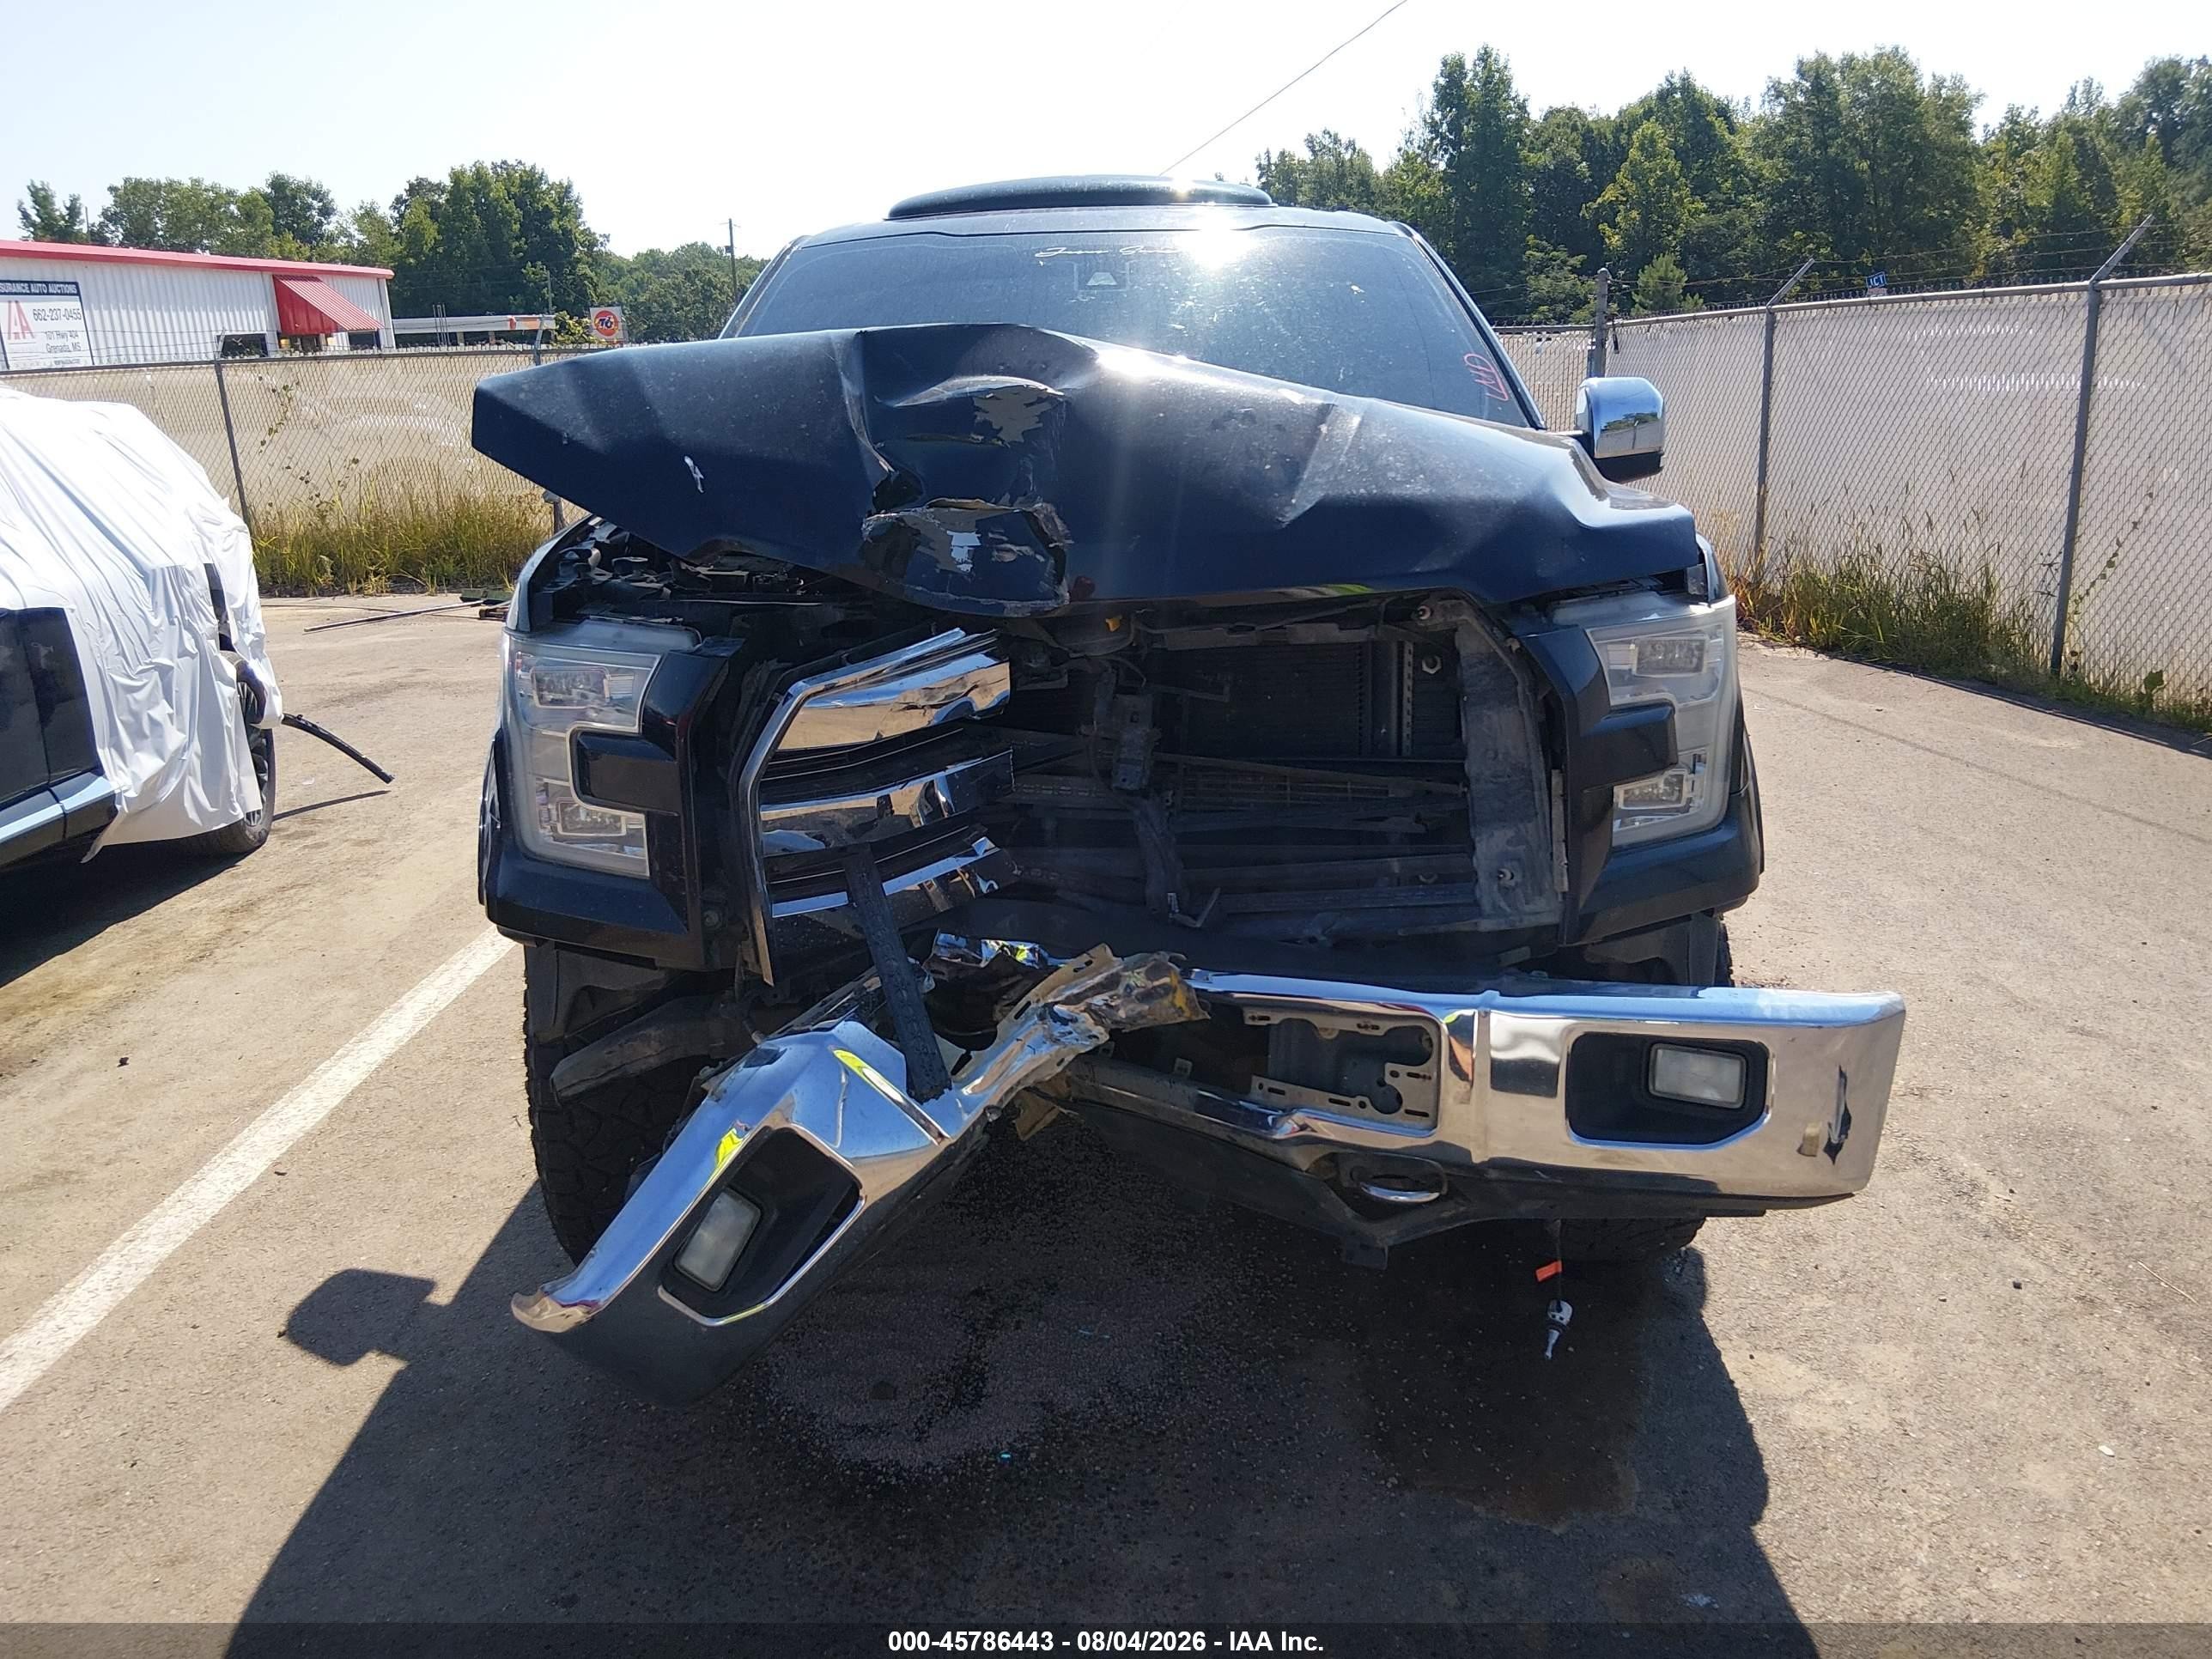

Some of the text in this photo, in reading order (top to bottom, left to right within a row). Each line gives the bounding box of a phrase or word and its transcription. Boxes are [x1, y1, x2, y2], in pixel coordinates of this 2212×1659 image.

[30, 283, 47, 294] AUTO
[48, 283, 77, 294] AUCTIONS
[33, 307, 82, 322] 662-237-0455
[599, 315, 614, 329] 76
[56, 331, 68, 342] Hwy
[71, 342, 82, 352] MS
